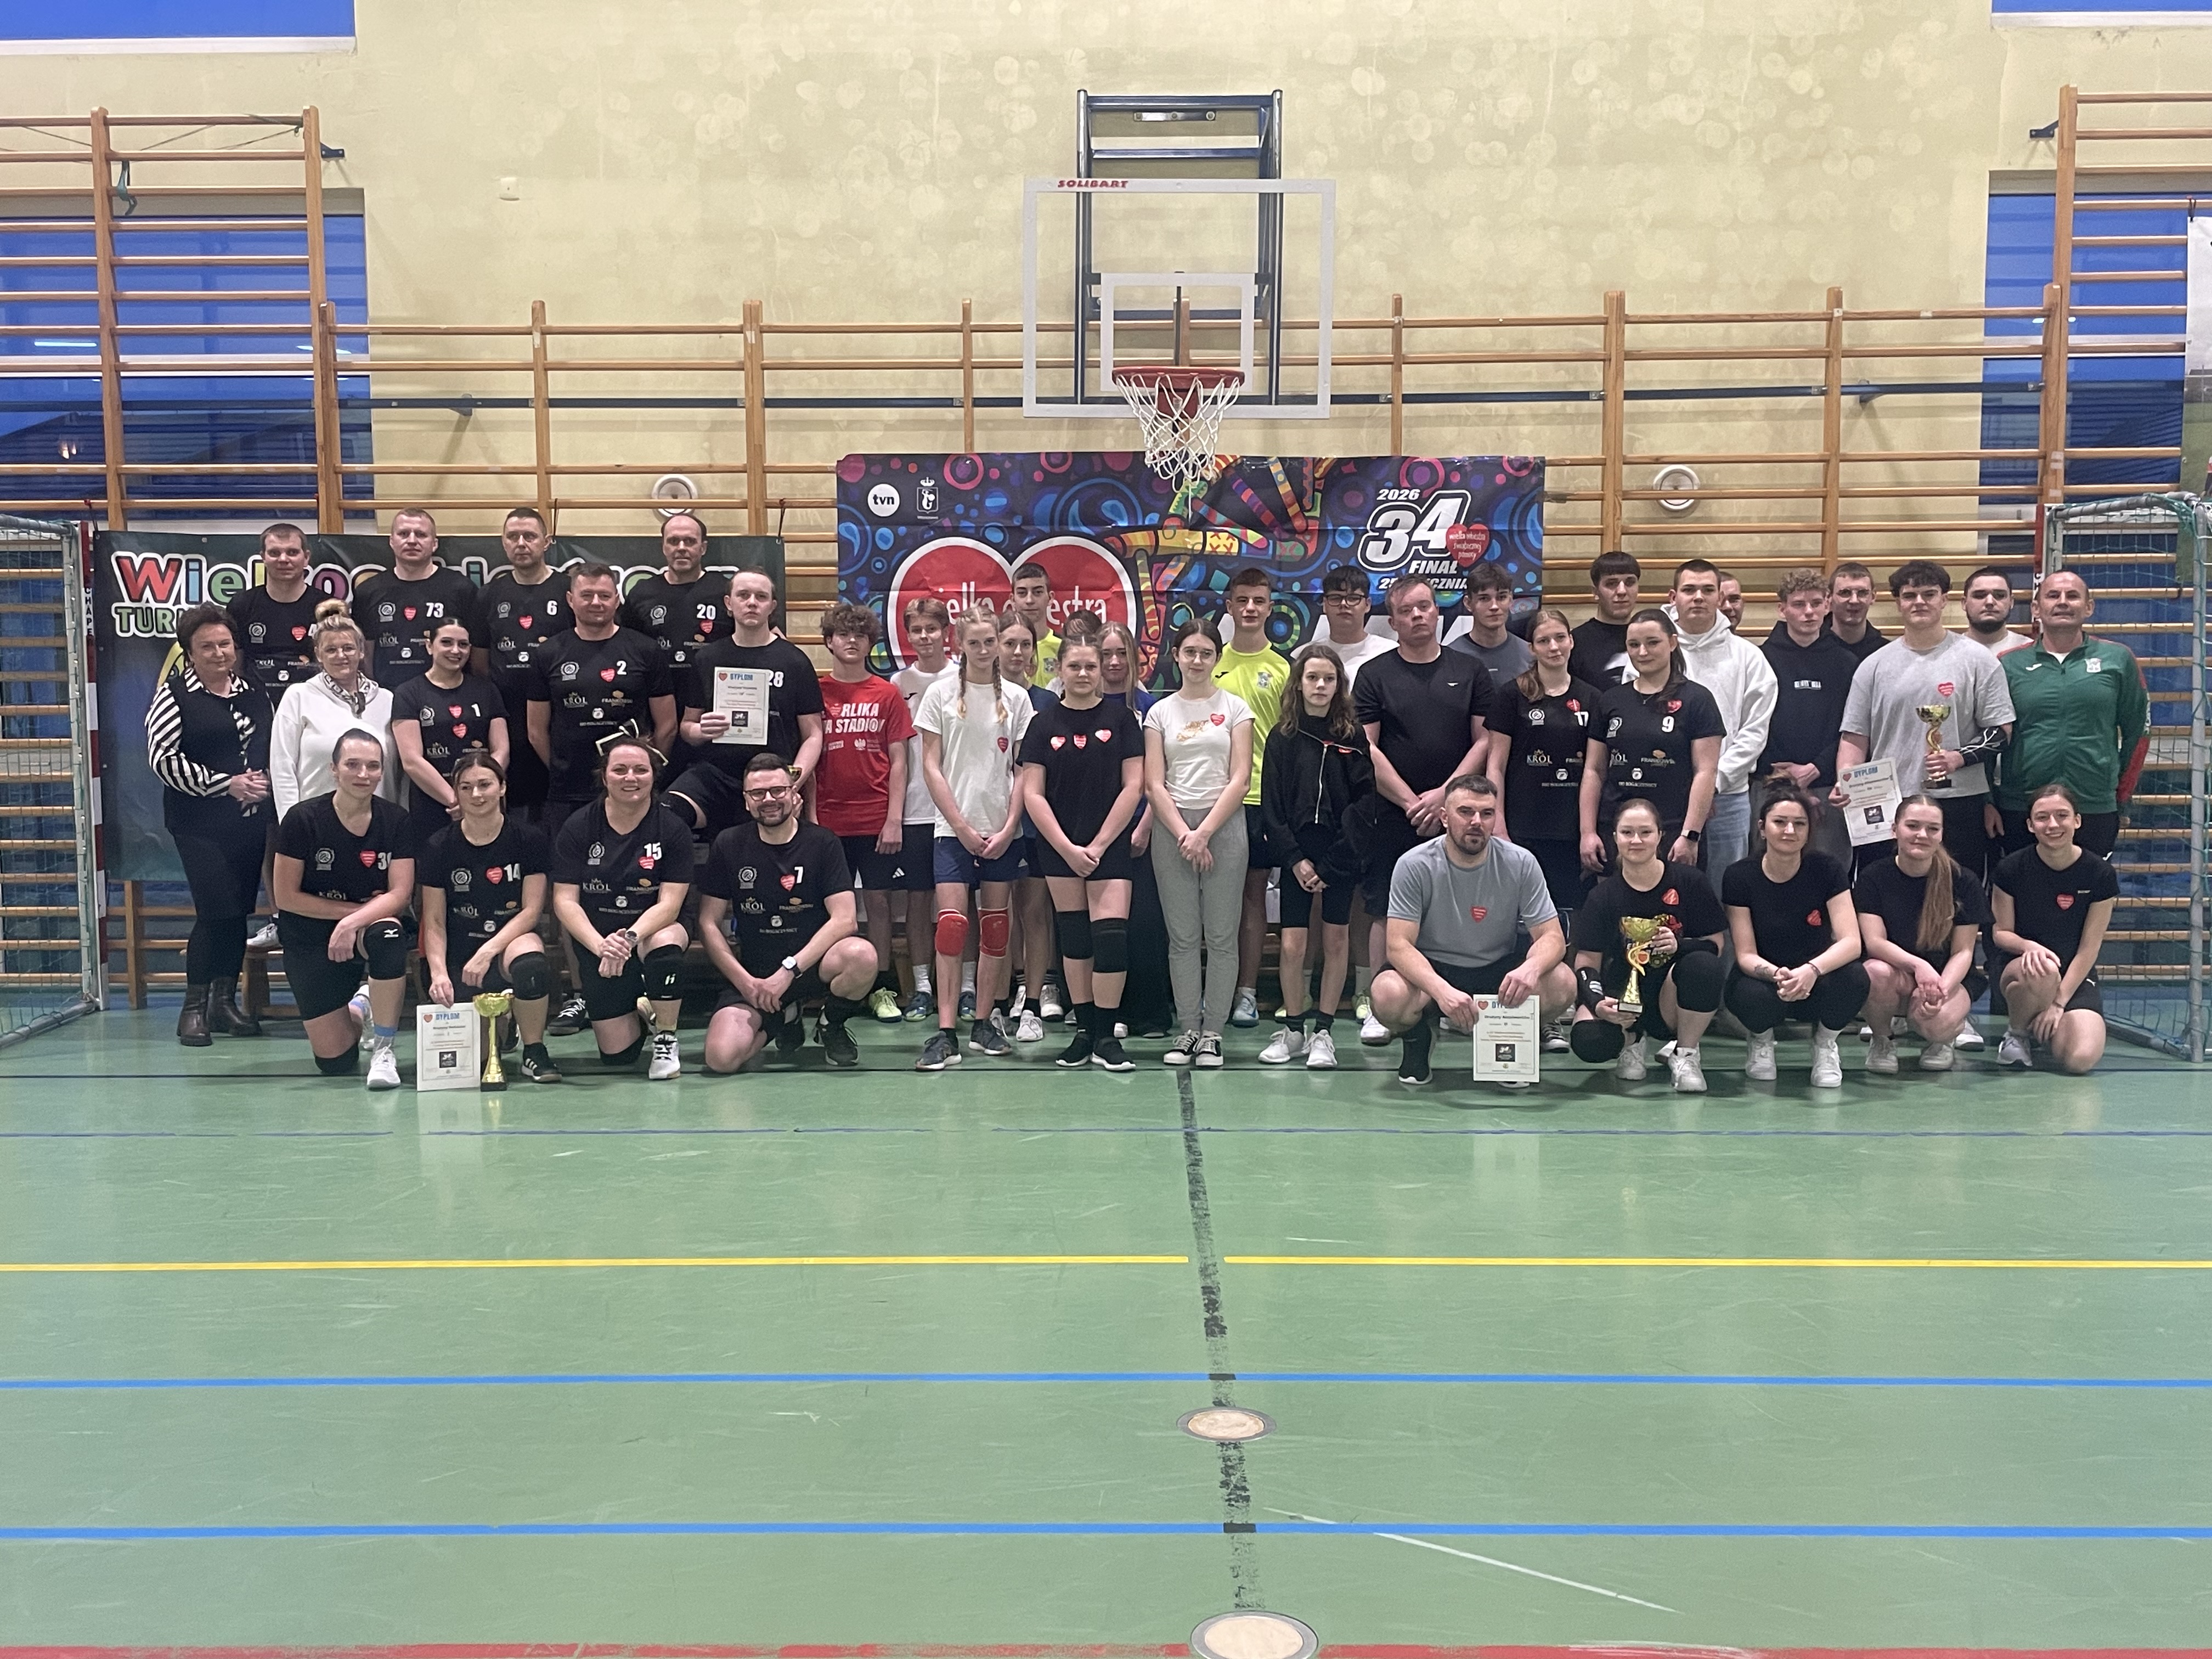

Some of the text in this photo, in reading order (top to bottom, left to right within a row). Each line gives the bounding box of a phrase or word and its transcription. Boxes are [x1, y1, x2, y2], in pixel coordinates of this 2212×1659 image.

[1057, 179, 1128, 188] SOLIBART
[872, 494, 895, 505] tvn
[1376, 489, 1420, 500] 2026
[1361, 493, 1467, 568] 34
[1408, 560, 1458, 574] FINAŁ
[426, 602, 444, 618] 73
[546, 600, 557, 616] 6
[696, 603, 716, 620] 20
[617, 660, 627, 675] 2
[769, 669, 784, 687] 28
[471, 703, 481, 717] 1
[840, 703, 879, 717] RLIKA
[1574, 711, 1589, 727] 17
[1661, 715, 1675, 733] 9
[644, 842, 663, 860] 15
[504, 863, 521, 882] 14
[794, 866, 804, 884] 7
[436, 1012, 460, 1020] DYPLOM
